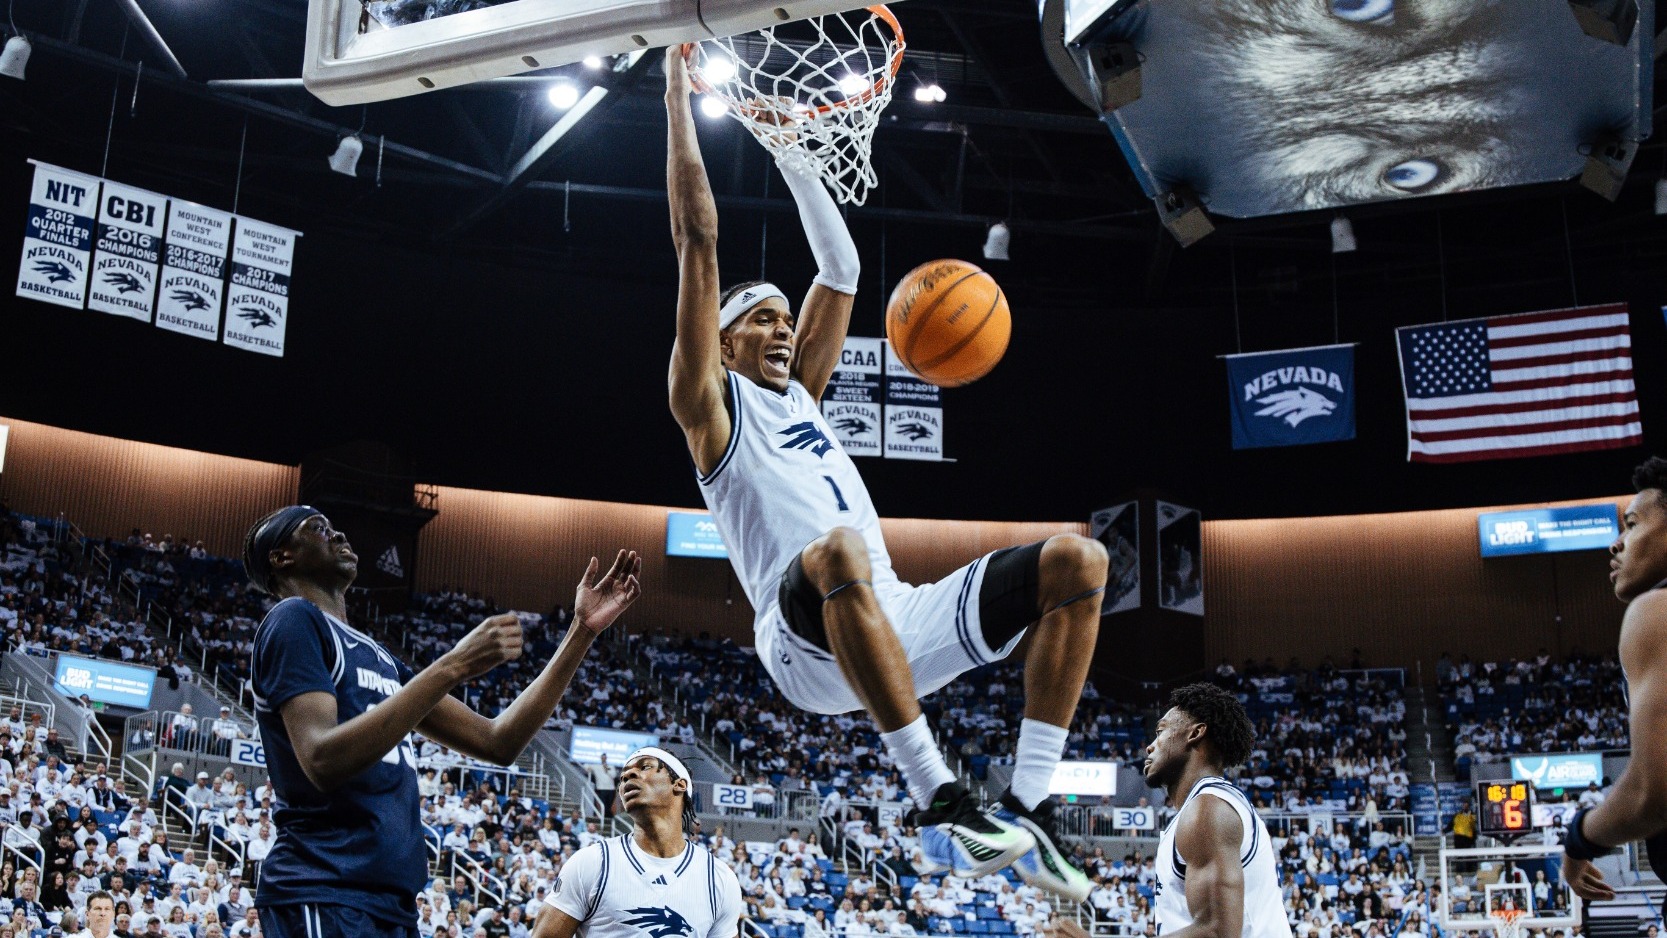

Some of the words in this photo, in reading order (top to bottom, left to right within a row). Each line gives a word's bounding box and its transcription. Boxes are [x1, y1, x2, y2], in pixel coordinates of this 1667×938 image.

[45, 179, 86, 207] NIT
[45, 208, 75, 225] 2012
[107, 195, 156, 228] CBI
[177, 210, 223, 229] MOUNTAIN
[31, 216, 90, 240] QUARTER
[39, 229, 79, 247] FINALS
[105, 225, 151, 248] 2016
[186, 223, 211, 236] WEST
[243, 228, 287, 246] MOUNTAIN
[171, 229, 224, 250] CONFERENCE
[252, 240, 277, 254] WEST
[26, 246, 83, 272] NEVADA
[97, 238, 158, 262] CHAMPIONS
[167, 245, 224, 268] 2016-2017
[236, 247, 290, 267] TOURNAMENT
[97, 258, 151, 283] NEVADA
[167, 256, 220, 277] CHAMPIONS
[246, 267, 275, 282] 2017
[20, 281, 82, 301] BASKETBALL
[164, 276, 217, 301] NEVADA
[232, 272, 288, 295] CHAMPIONS
[92, 291, 149, 312] BASKETBALL
[231, 294, 282, 318] NEVADA
[159, 312, 216, 333] BASKETBALL
[227, 330, 282, 350] BASKETBALL
[841, 350, 878, 367] CAA
[835, 386, 869, 395] SWEET
[1244, 366, 1344, 402] NEVADA
[832, 393, 873, 402] SIXTEEN
[889, 392, 939, 401] CHAMPIONS
[828, 405, 877, 422] NEVADA
[889, 410, 939, 428] NEVADA
[888, 443, 940, 454] BASKETBALL
[822, 475, 850, 511] 1
[1494, 520, 1528, 533] BUD
[1489, 530, 1535, 546] LIGHT
[60, 675, 93, 689] LIGHT
[66, 667, 91, 680] BUD
[356, 667, 384, 695] UTAH
[239, 743, 266, 764] 26
[1547, 766, 1569, 780] AIR
[720, 787, 746, 805] 28
[1120, 811, 1146, 827] 30
[1504, 800, 1523, 828] 6
